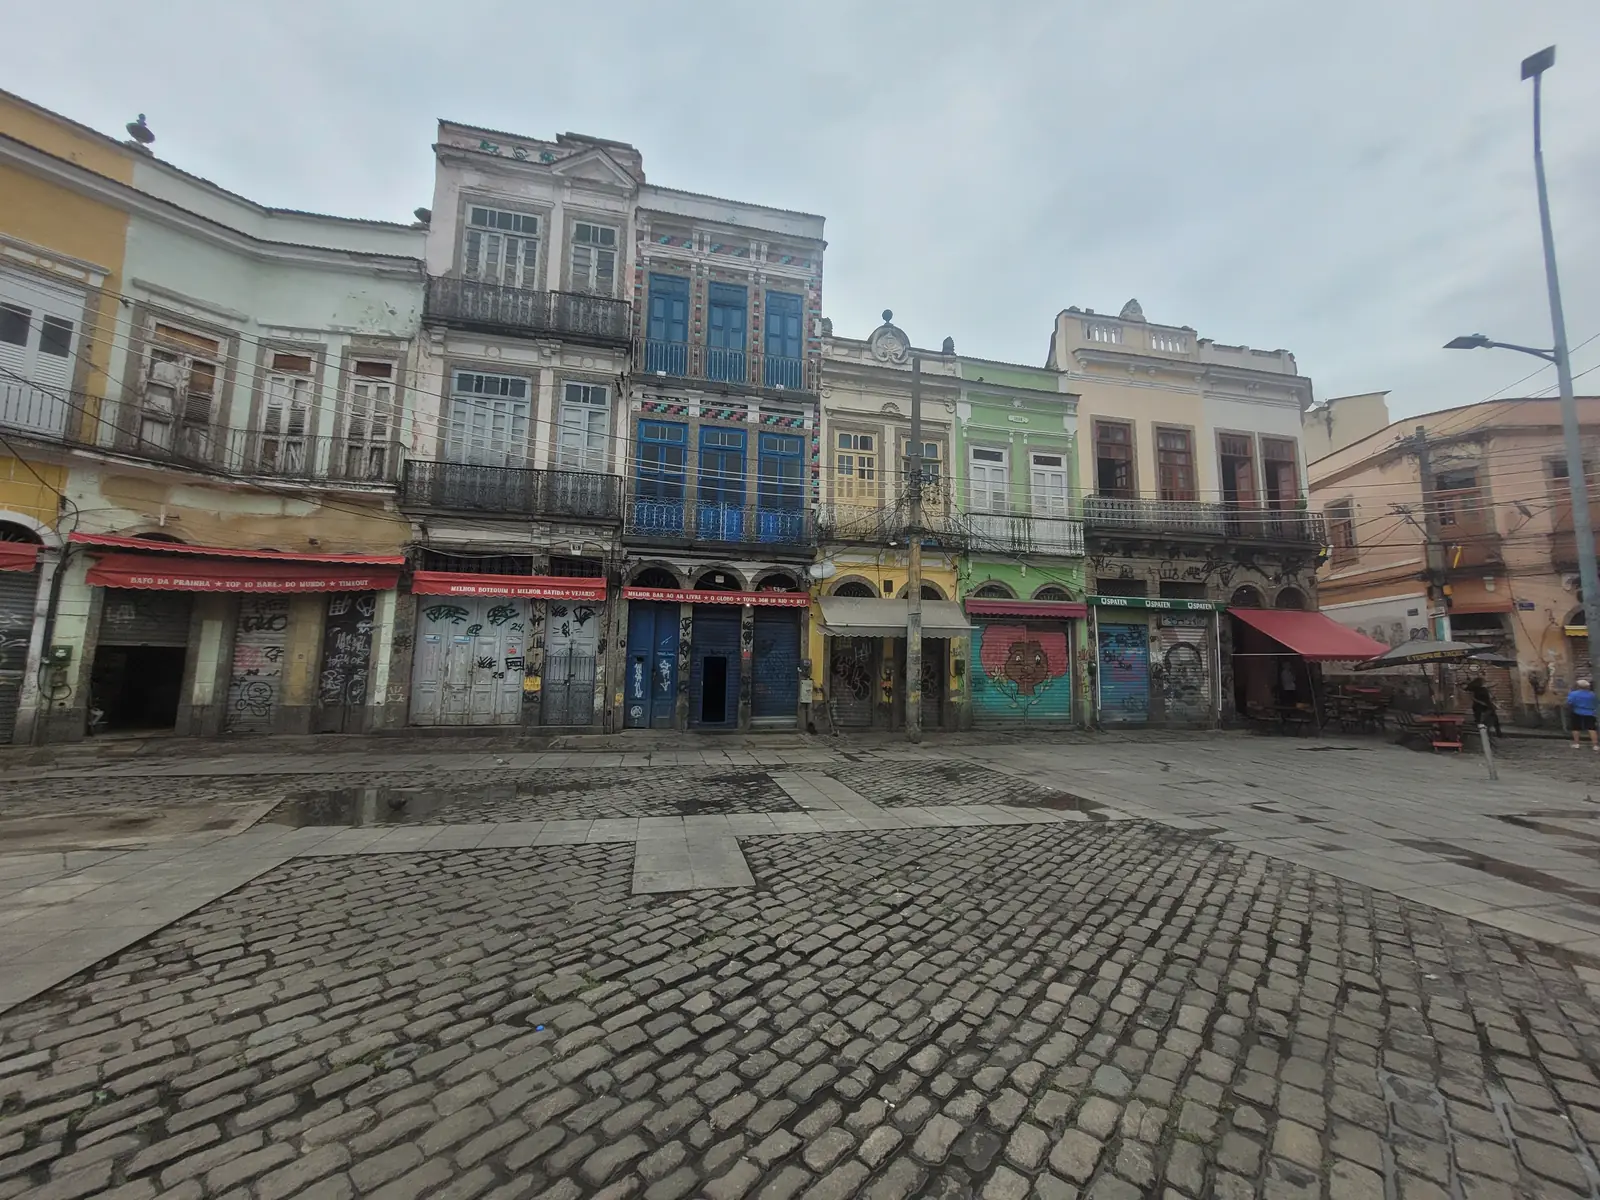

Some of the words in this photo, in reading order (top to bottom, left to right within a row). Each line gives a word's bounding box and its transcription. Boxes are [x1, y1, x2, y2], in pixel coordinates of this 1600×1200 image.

[173, 579, 210, 587] PRAINHA
[339, 579, 368, 587] TIMEOUT
[1106, 598, 1128, 606] SPATEN
[1150, 600, 1171, 608] SPATEN
[1193, 602, 1212, 610] SPATEN
